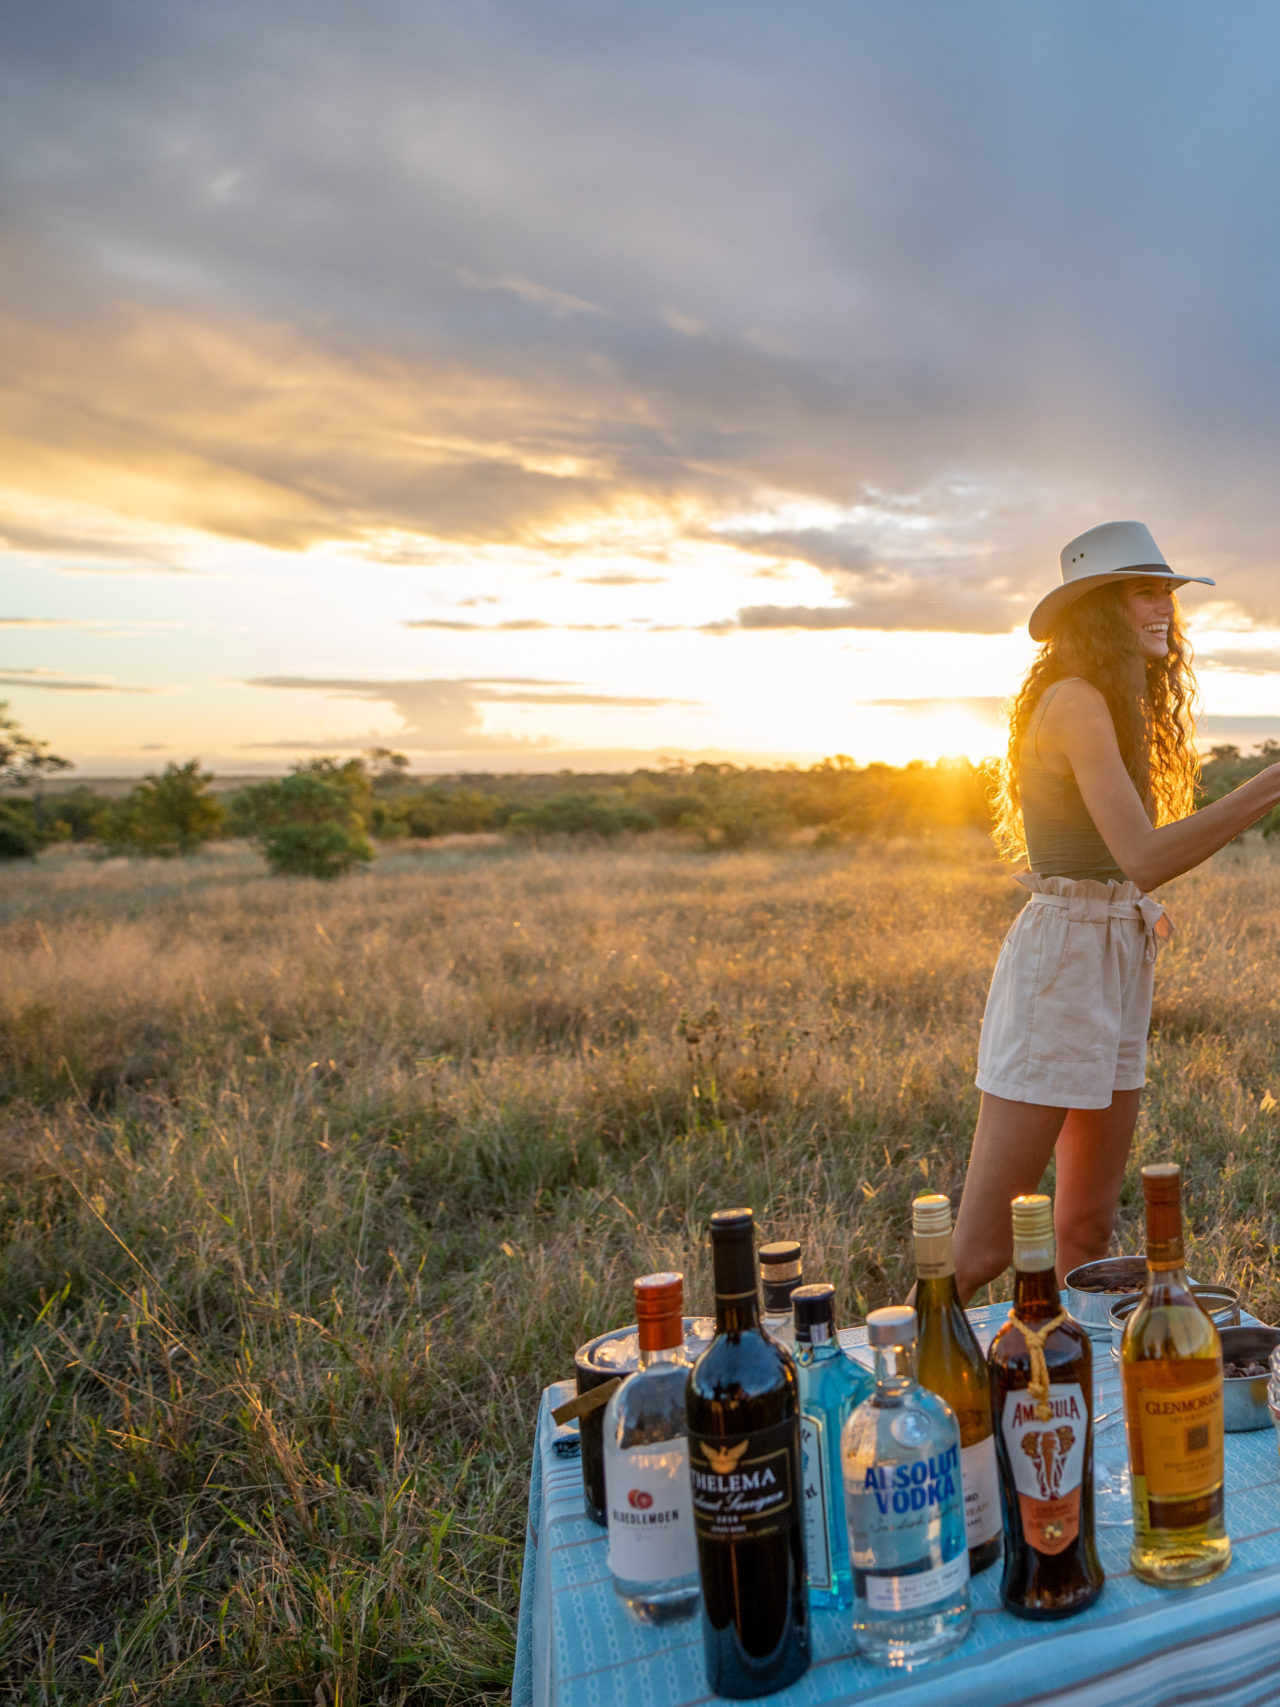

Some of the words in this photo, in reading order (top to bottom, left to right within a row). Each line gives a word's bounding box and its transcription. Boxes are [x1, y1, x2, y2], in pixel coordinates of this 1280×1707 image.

[1012, 1395, 1080, 1428] AMULA
[1145, 1388, 1220, 1415] GLENMORAN
[865, 1444, 957, 1490] ABSOLUT
[875, 1474, 955, 1515] VODKA
